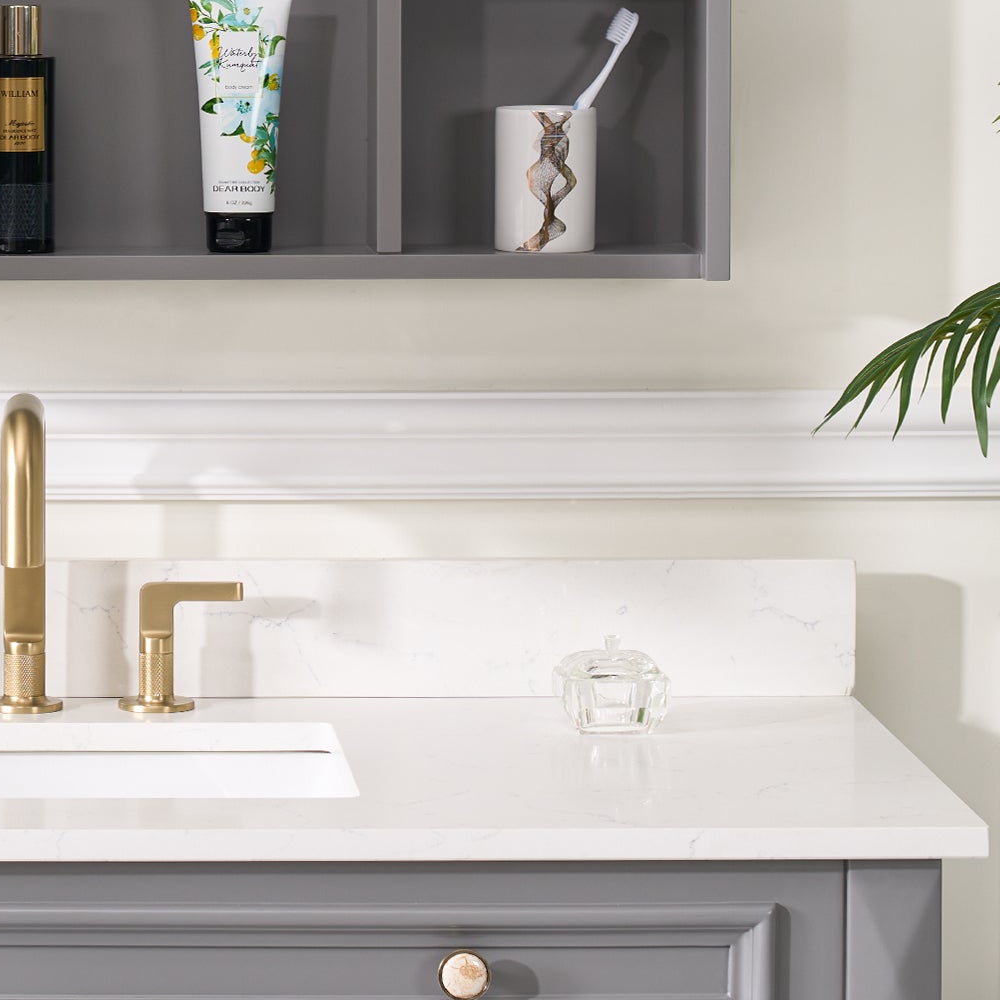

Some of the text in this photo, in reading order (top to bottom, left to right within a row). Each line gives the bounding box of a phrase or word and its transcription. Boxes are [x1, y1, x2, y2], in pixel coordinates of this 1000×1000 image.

[0, 90, 39, 98] WILLIAM
[212, 185, 266, 193] DEAR BODY
